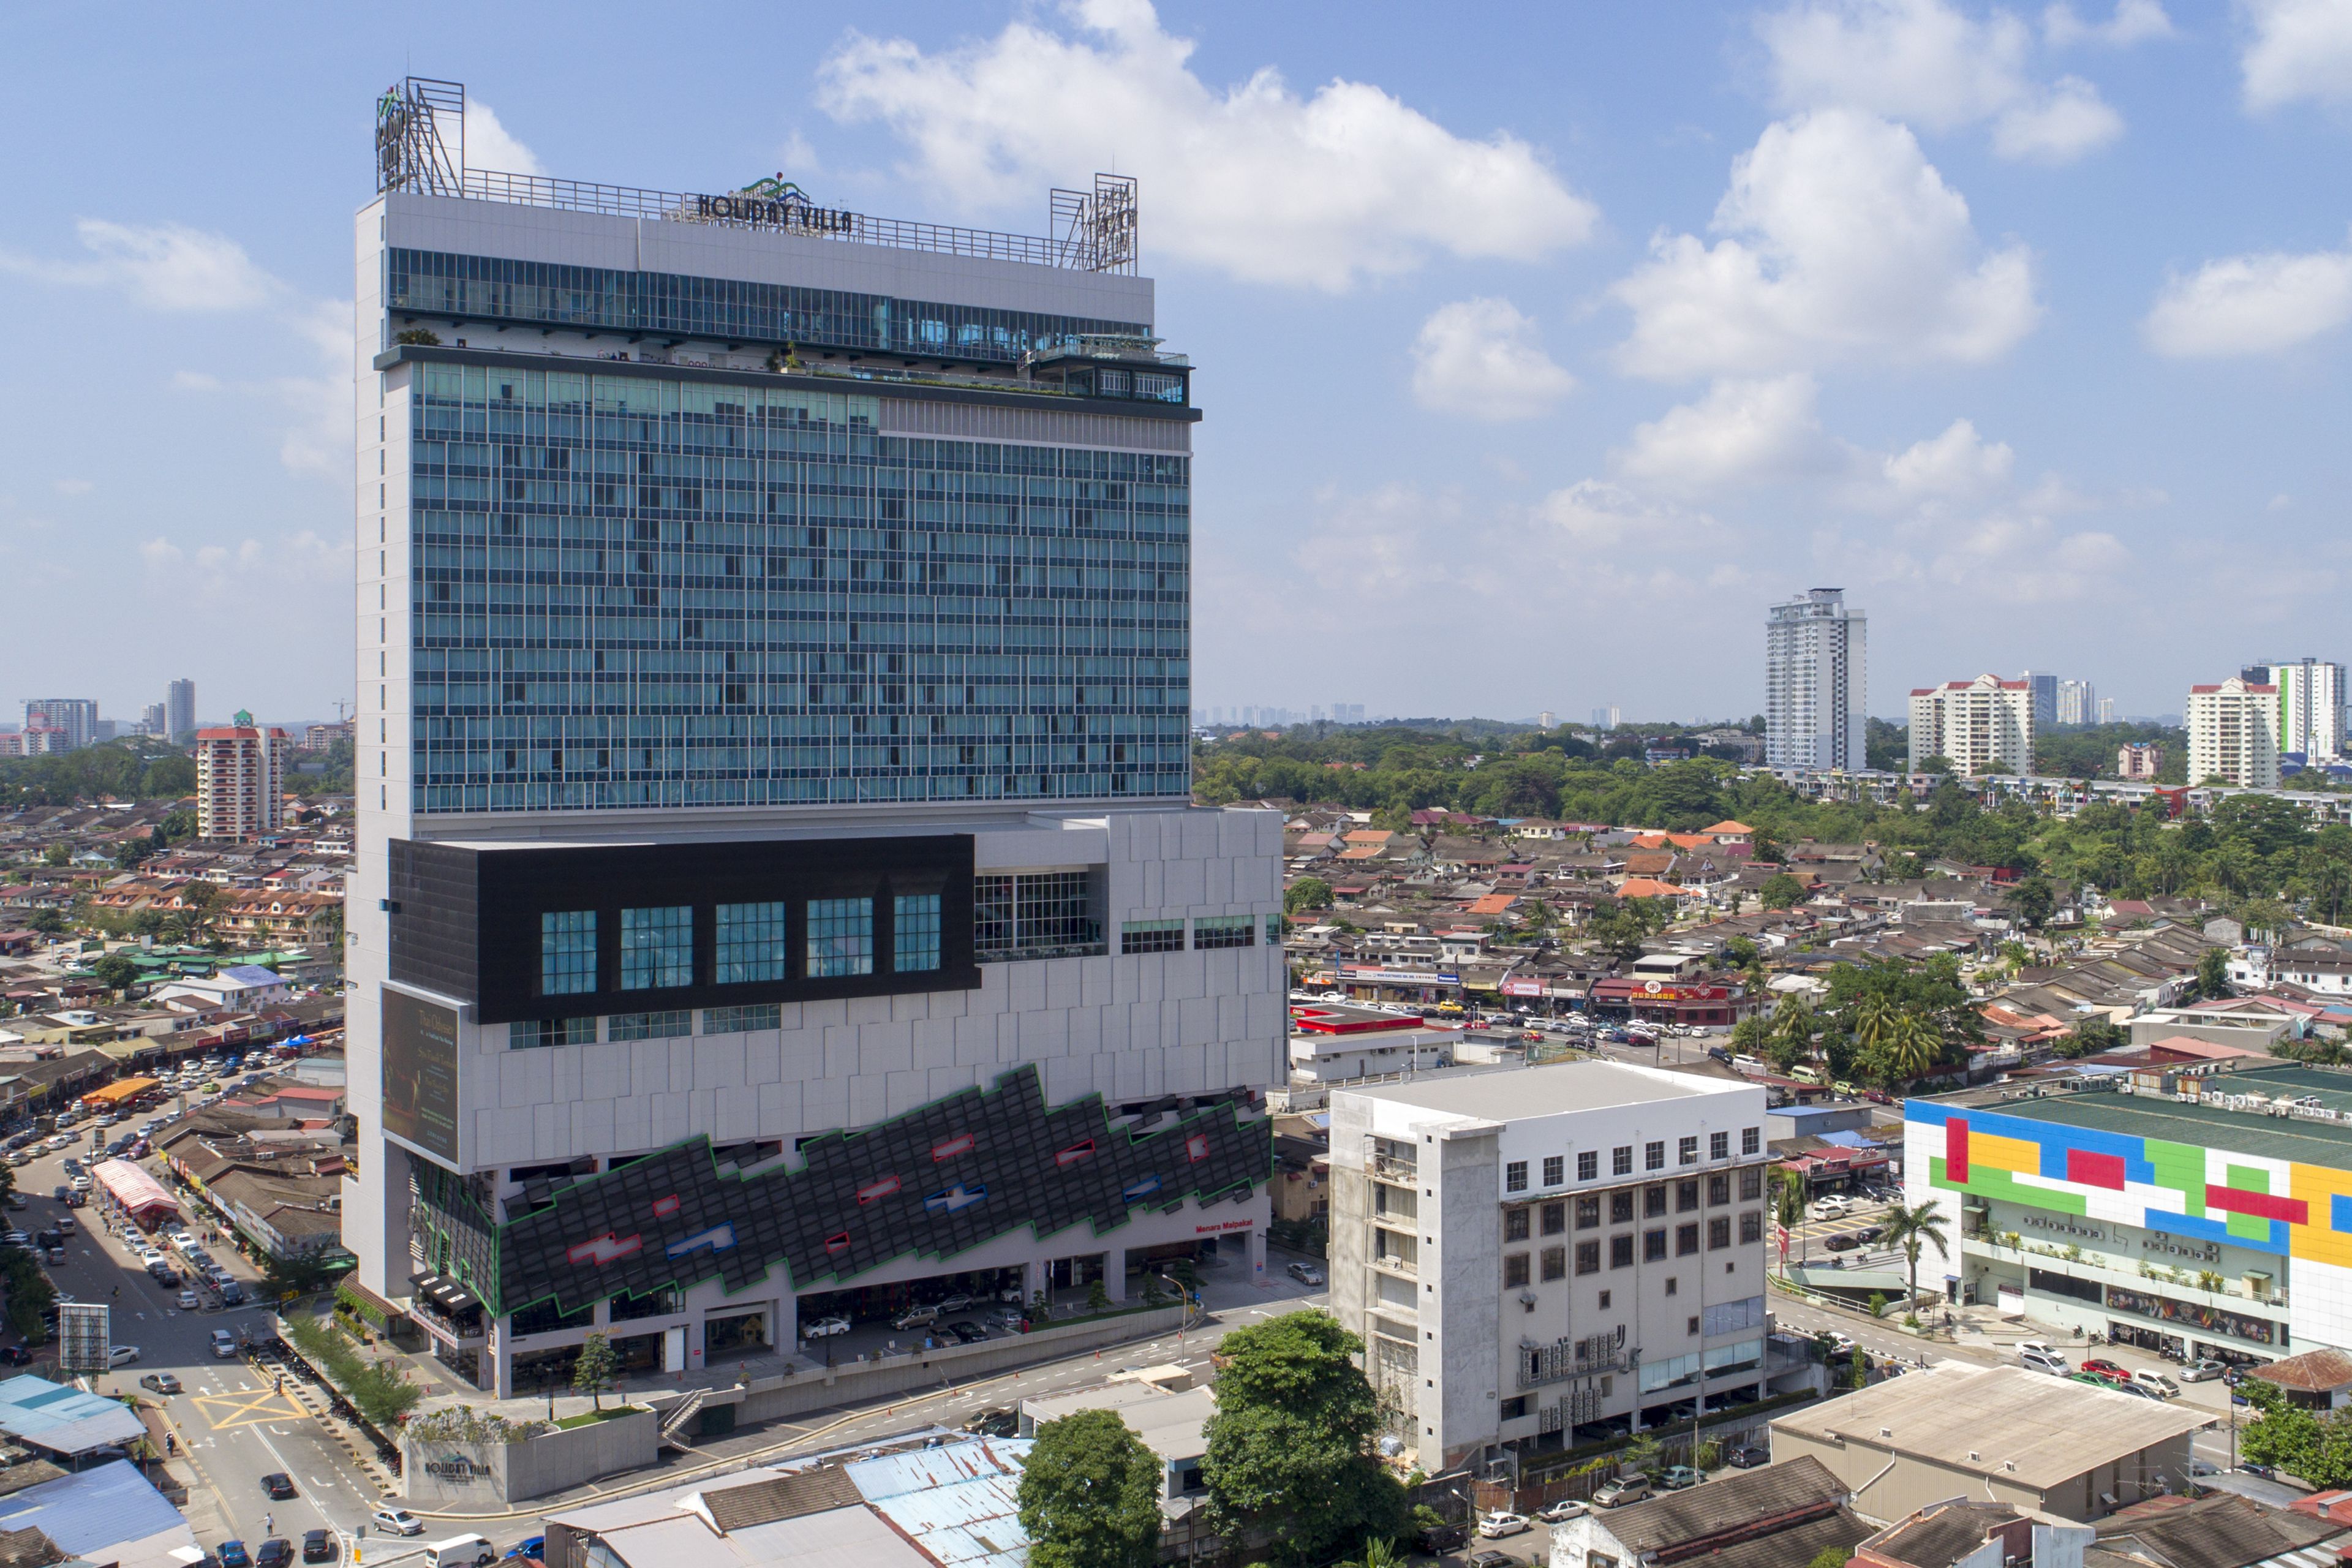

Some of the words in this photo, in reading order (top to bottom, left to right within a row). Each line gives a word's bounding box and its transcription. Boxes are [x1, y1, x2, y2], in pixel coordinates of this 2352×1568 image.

[698, 194, 793, 225] HOLIDAY
[799, 206, 851, 232] VILLA
[1196, 1224, 1221, 1233] Menara
[425, 1462, 466, 1474] HOLIDAY
[469, 1464, 490, 1475] VILLA
